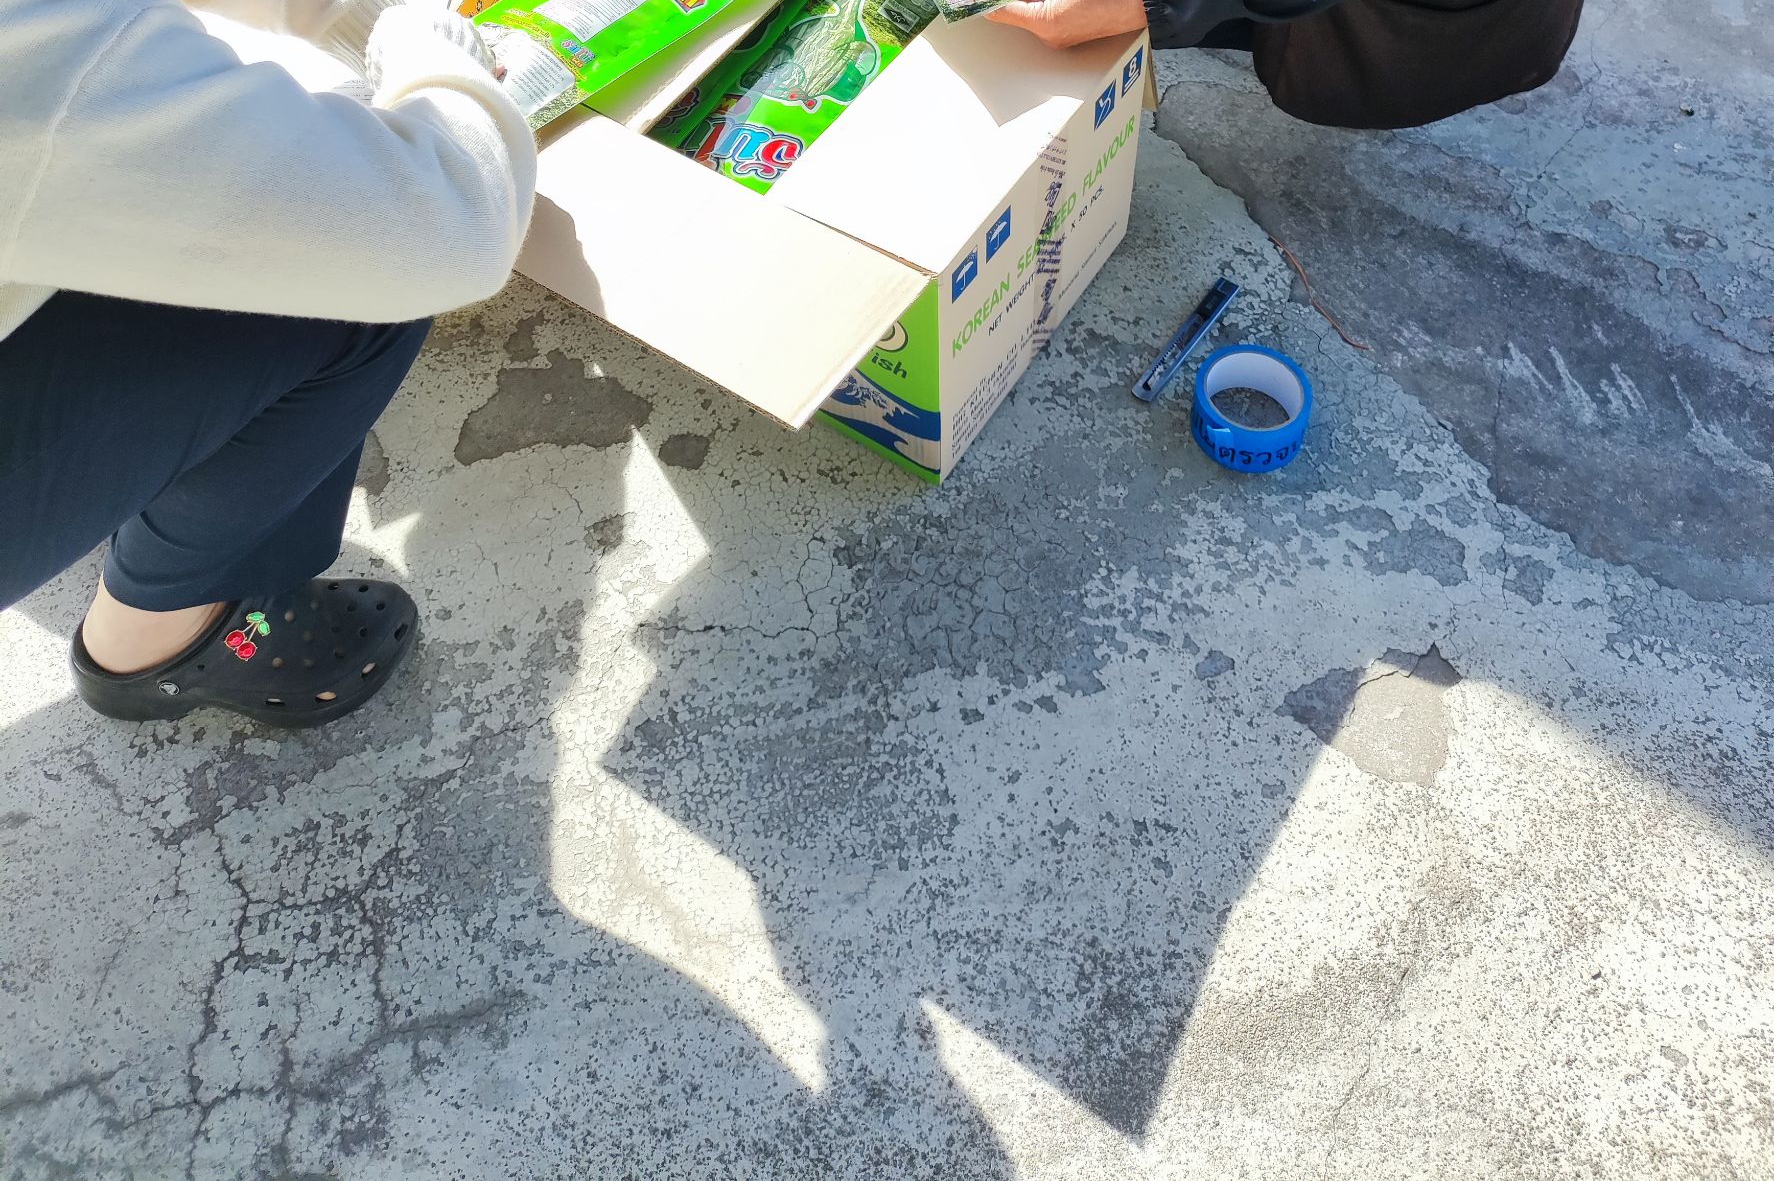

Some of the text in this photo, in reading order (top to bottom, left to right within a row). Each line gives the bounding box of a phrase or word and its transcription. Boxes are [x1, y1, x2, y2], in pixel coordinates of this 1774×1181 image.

[1128, 56, 1138, 78] 8
[952, 272, 1011, 359] KOREAN
[1082, 114, 1136, 196] FLAVOUR
[988, 312, 1003, 337] NET
[1006, 273, 1036, 314] WEIGHT
[1070, 220, 1077, 234] X
[1079, 206, 1088, 222] 50
[868, 349, 907, 379] ish
